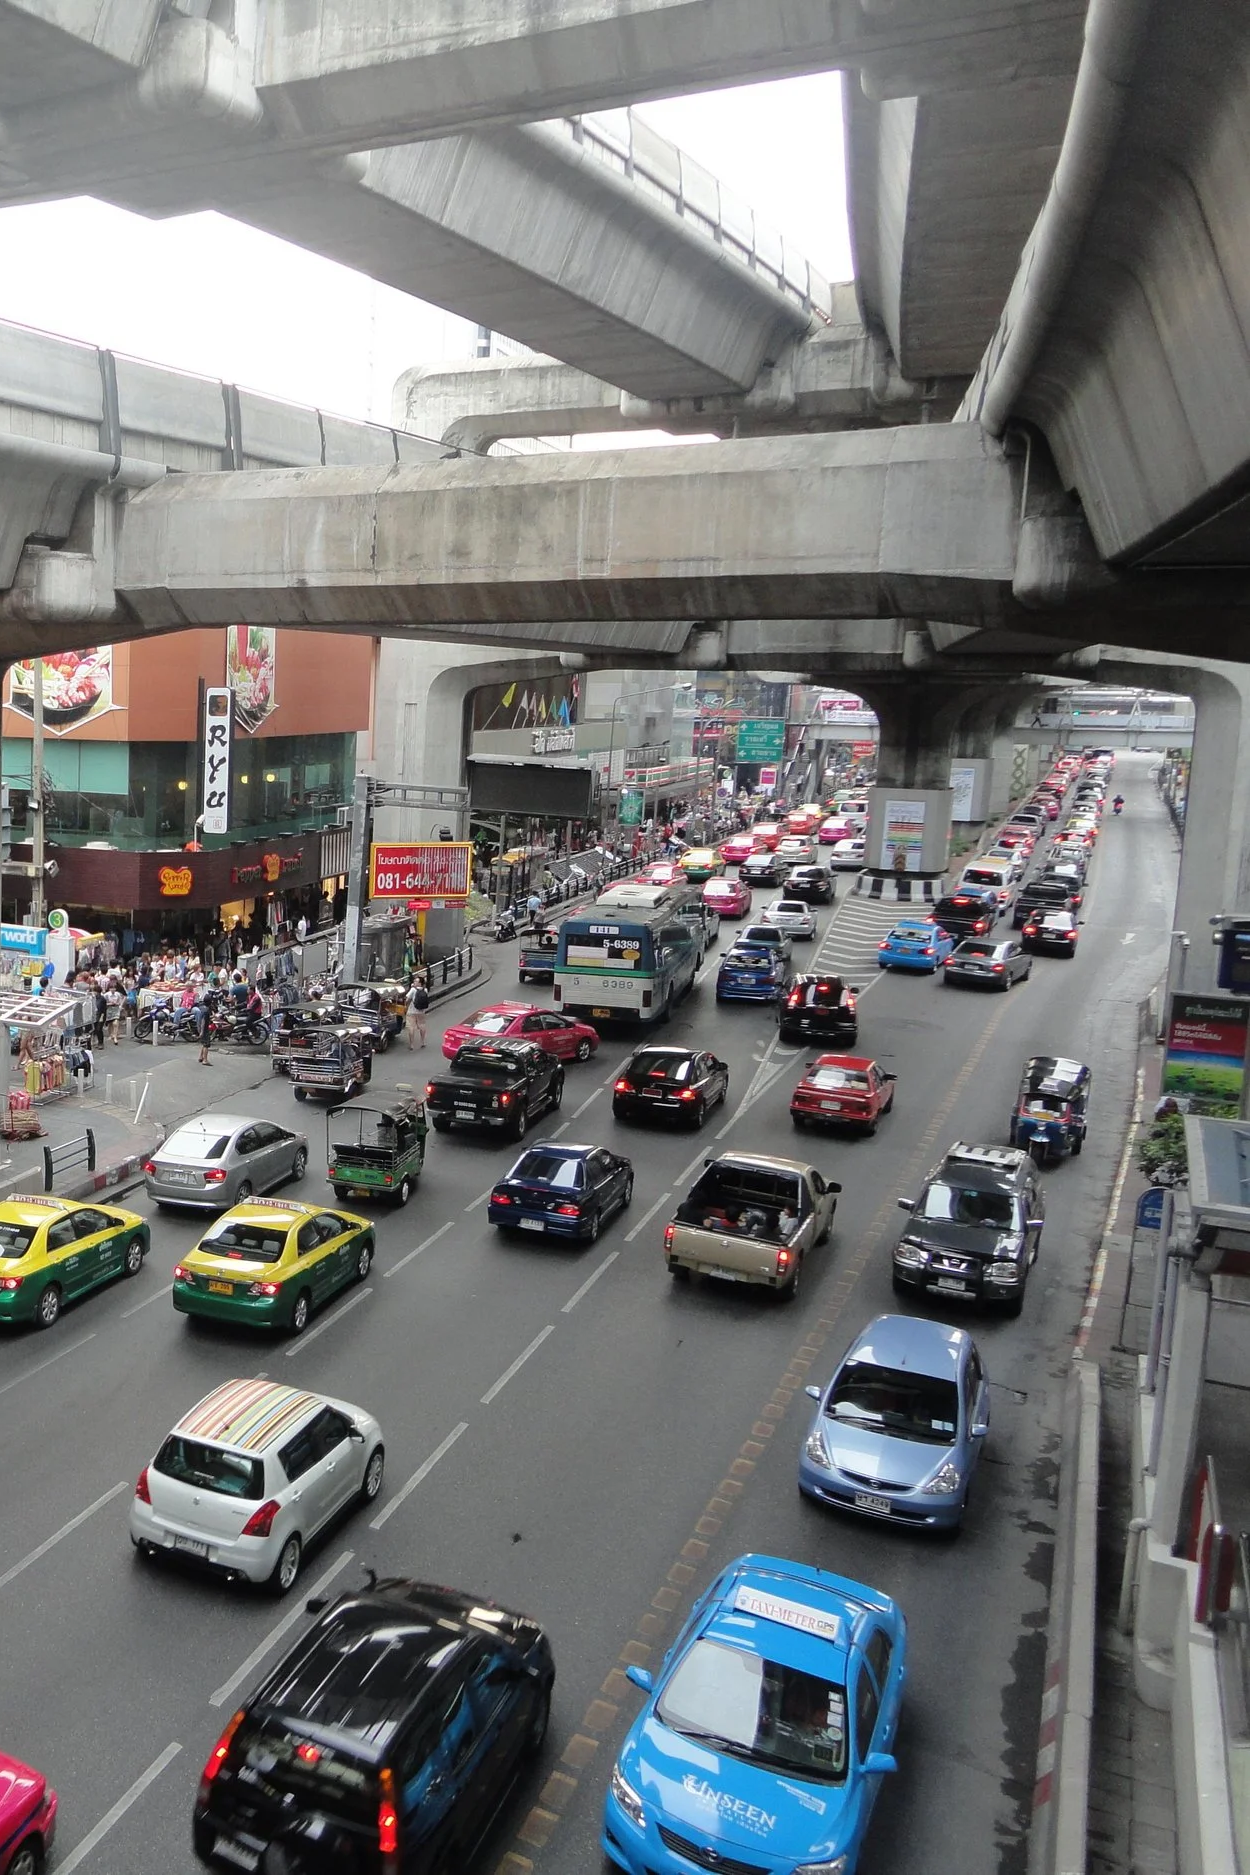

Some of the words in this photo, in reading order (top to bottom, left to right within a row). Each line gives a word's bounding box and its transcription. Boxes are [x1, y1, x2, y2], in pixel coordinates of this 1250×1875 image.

[53, 913, 61, 926] 3
[603, 939, 639, 950] 5-6389
[750, 1598, 816, 1629] TAXI-METER
[817, 1620, 835, 1632] GPS
